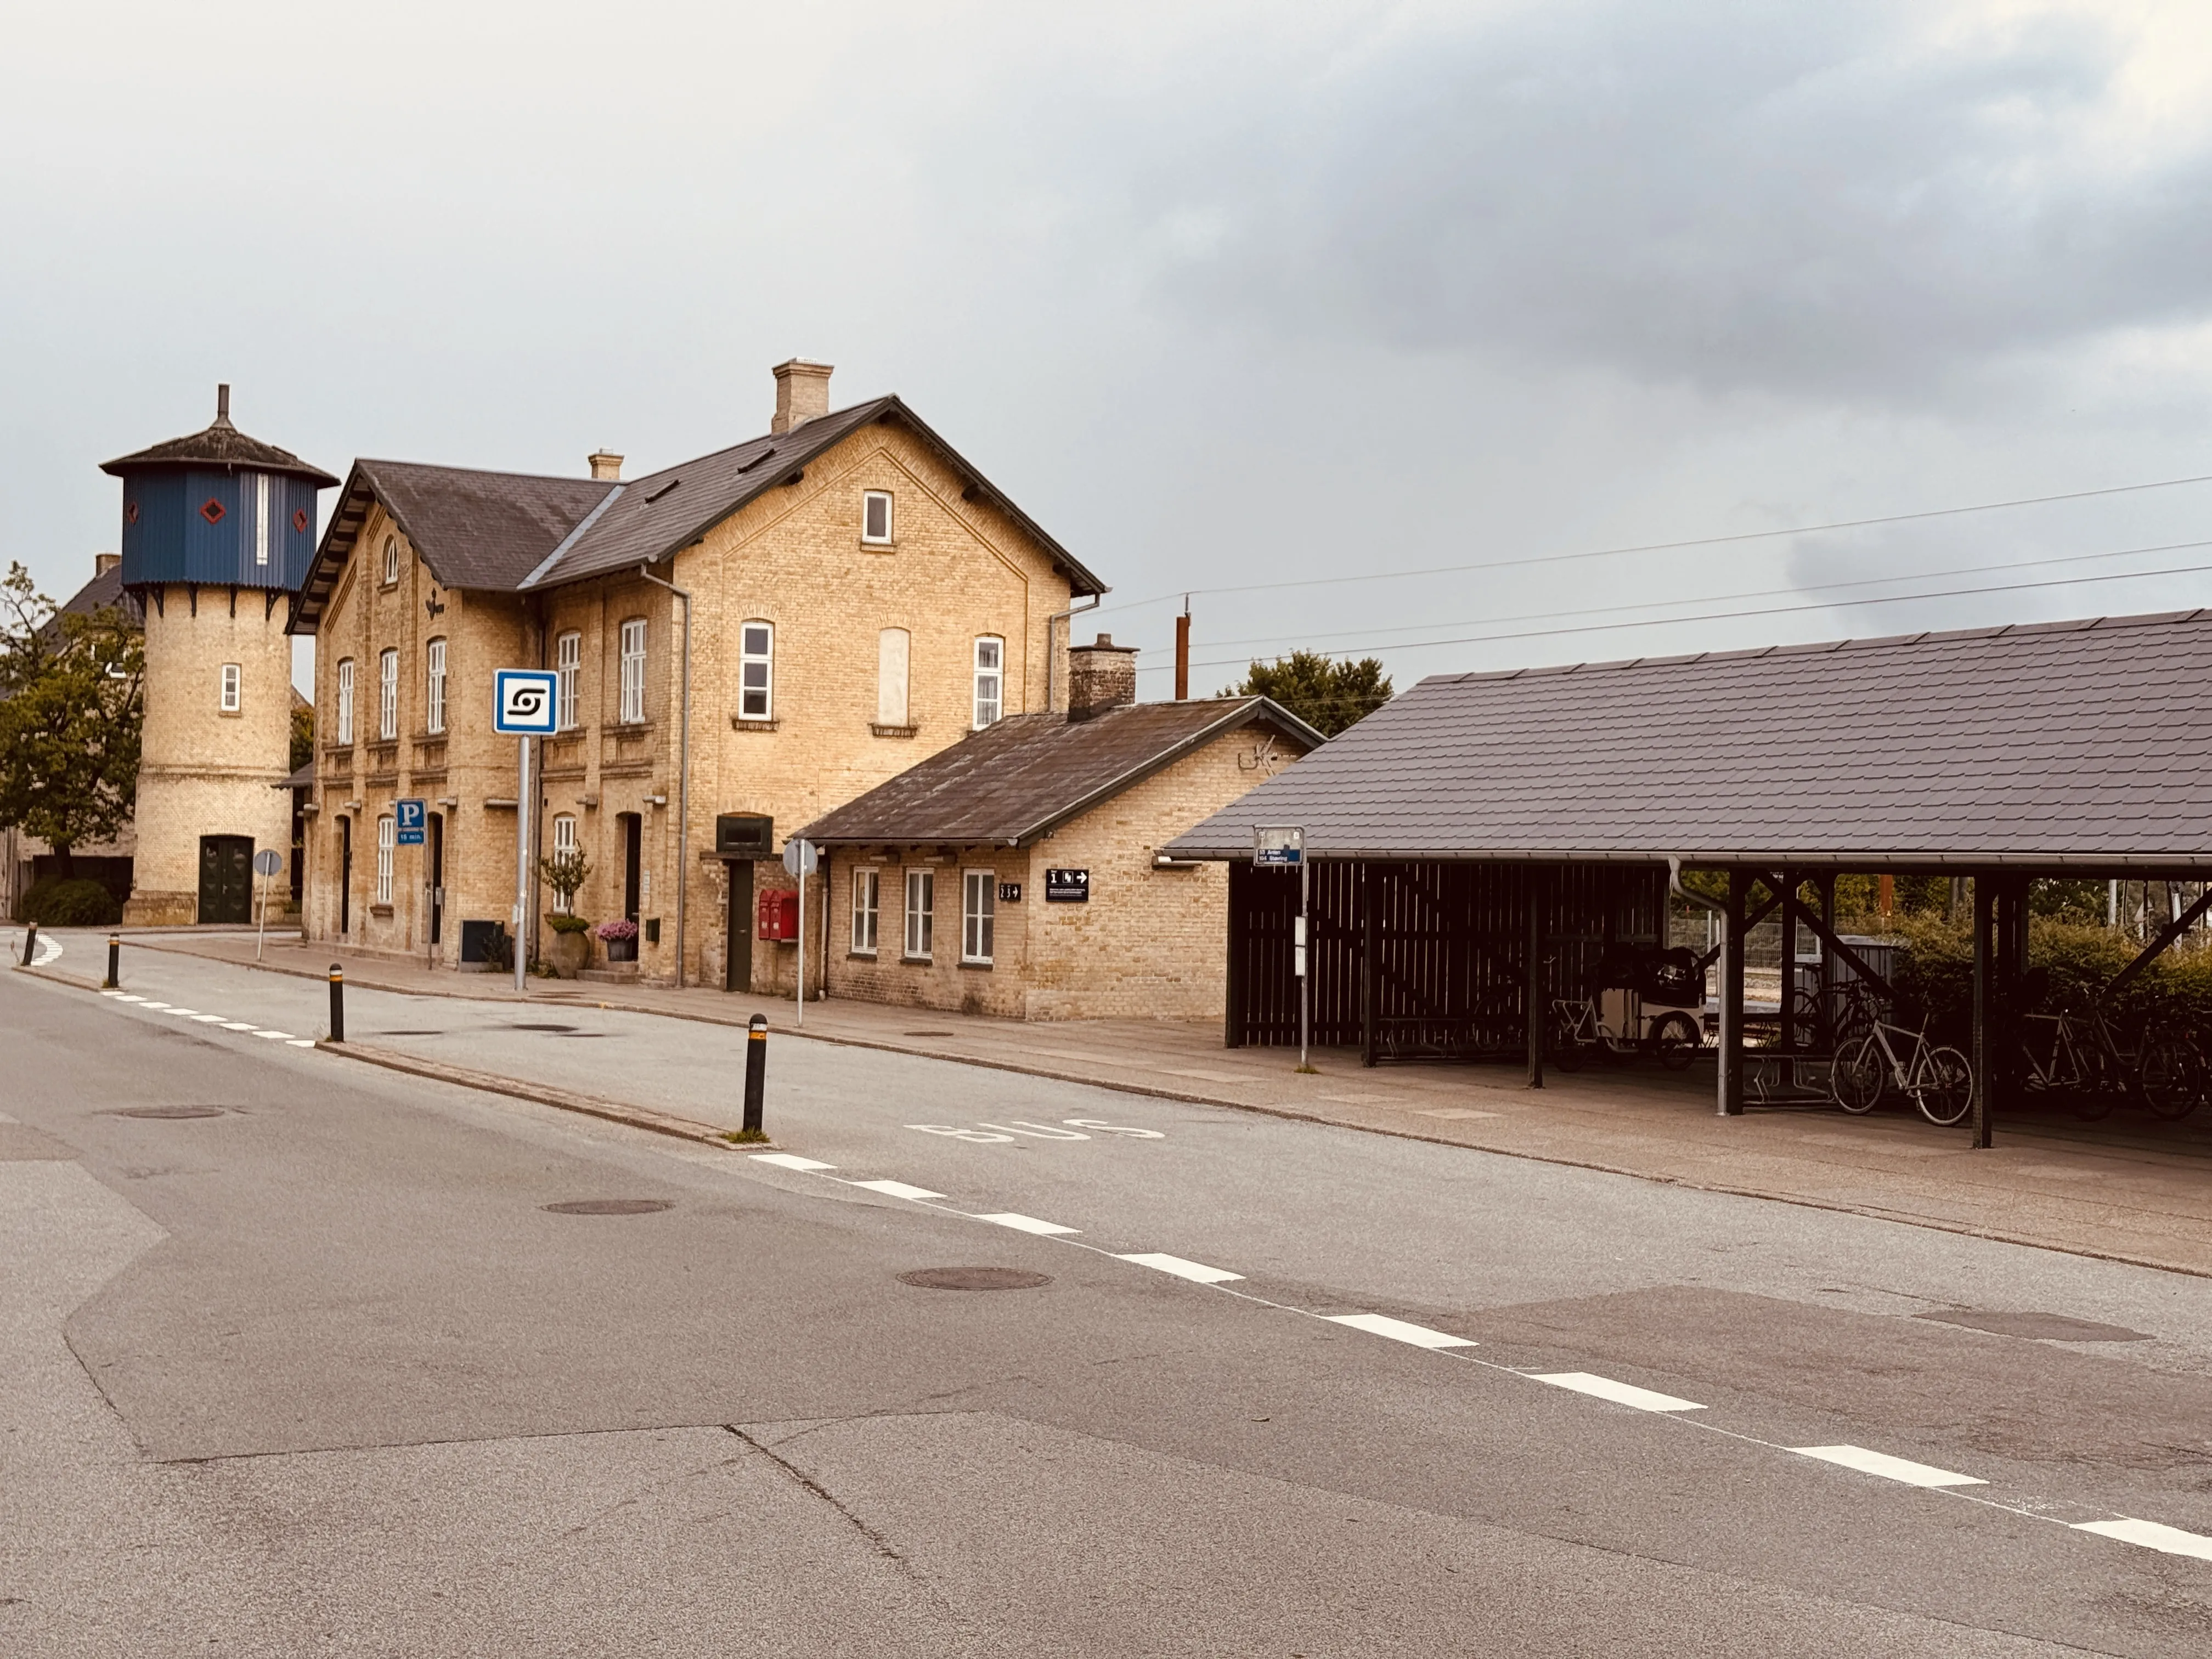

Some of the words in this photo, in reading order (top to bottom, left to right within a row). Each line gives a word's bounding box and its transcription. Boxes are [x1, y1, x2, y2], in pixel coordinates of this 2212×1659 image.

[401, 804, 420, 826] P
[1051, 873, 1057, 884] 1
[903, 1119, 1166, 1143] BUS
